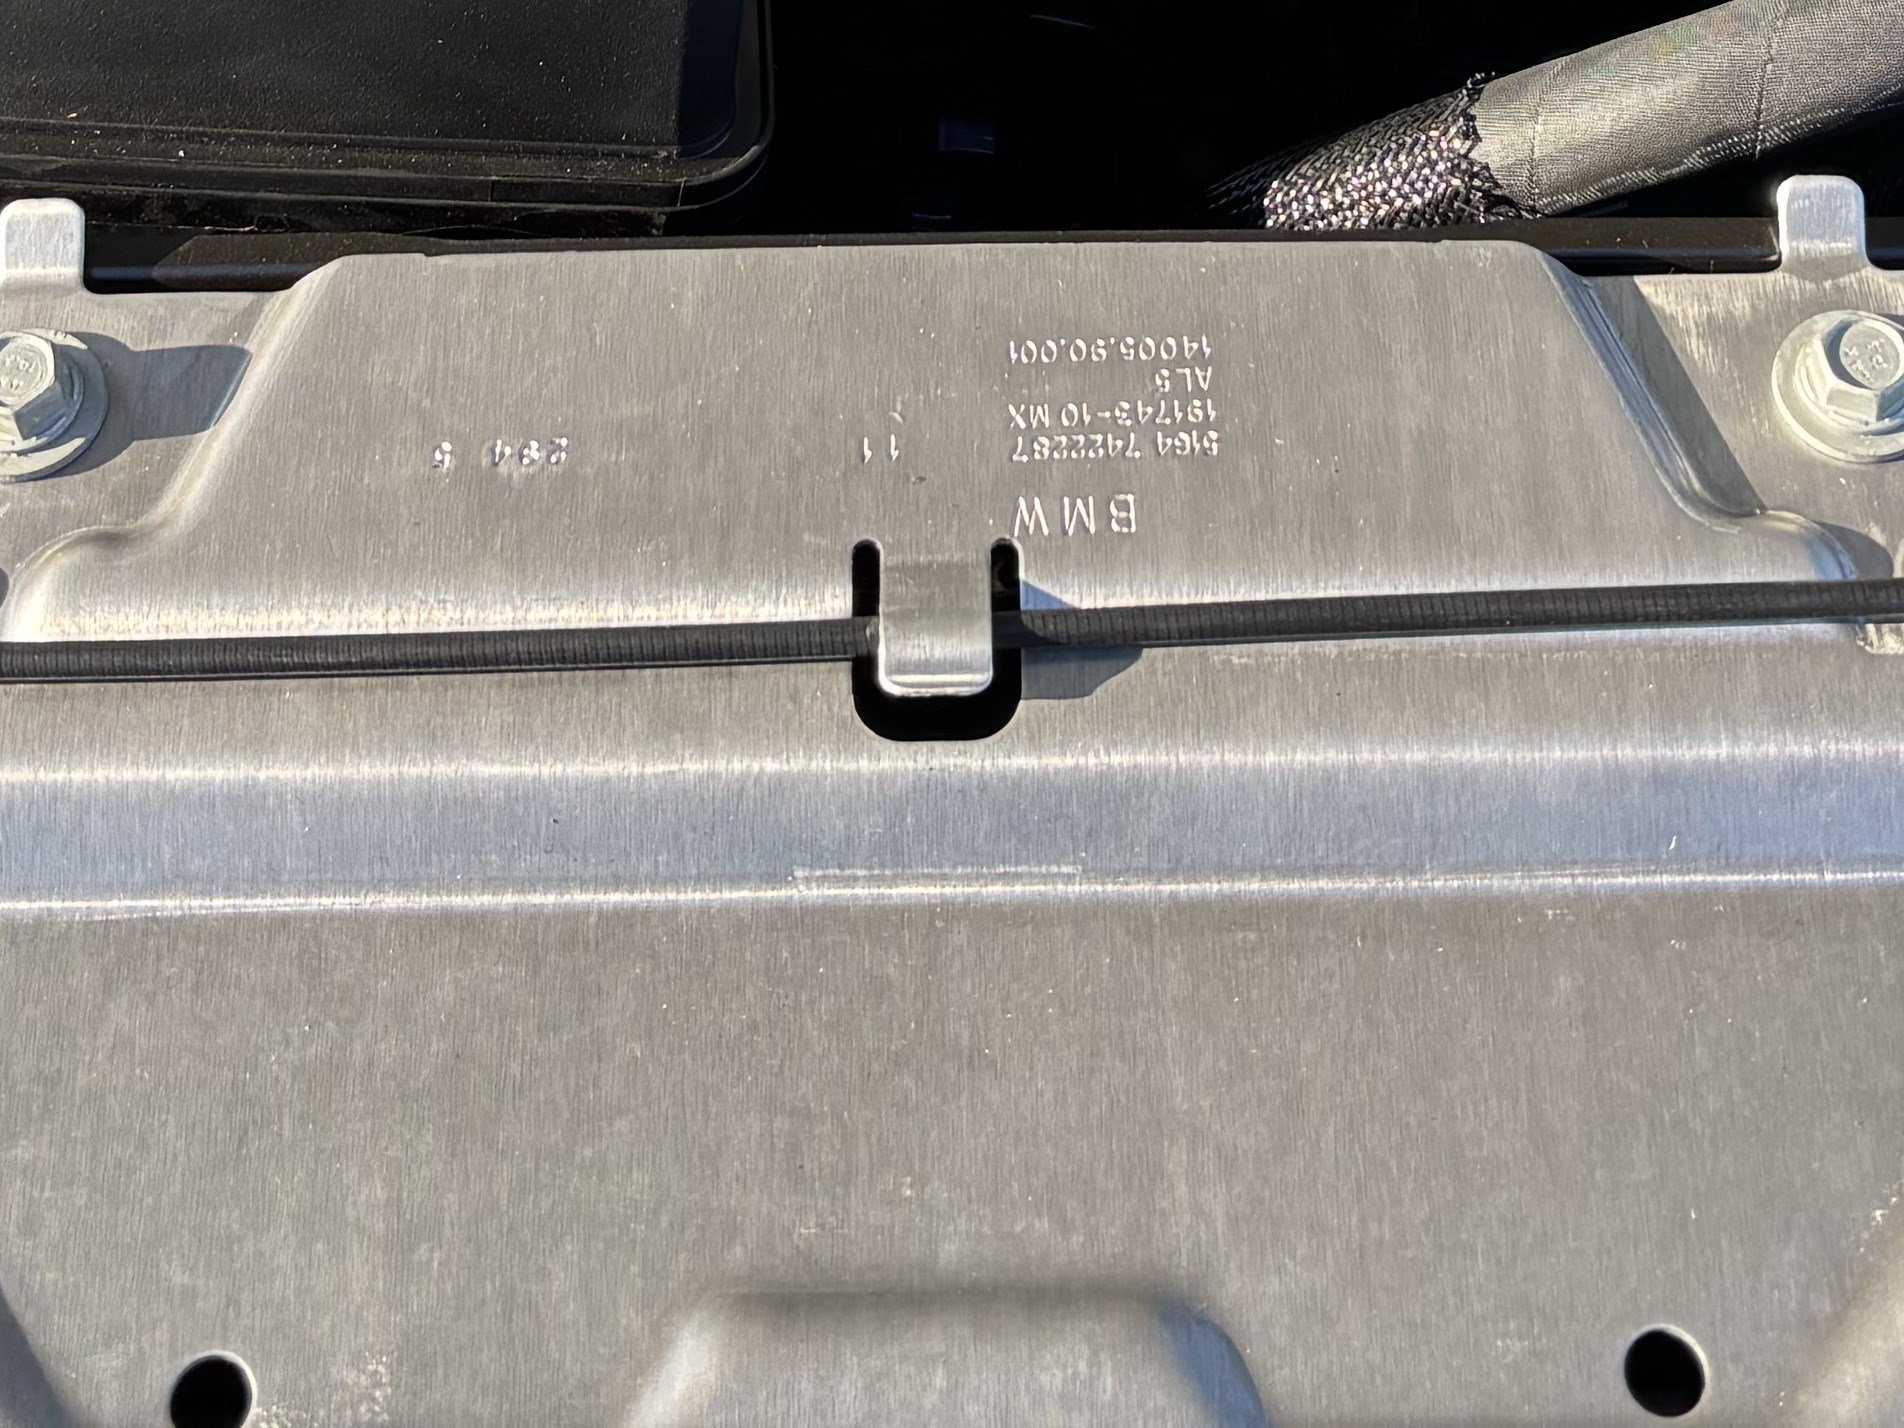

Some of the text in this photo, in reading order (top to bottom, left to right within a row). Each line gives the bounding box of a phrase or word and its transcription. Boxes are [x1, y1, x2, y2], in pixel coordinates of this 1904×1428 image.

[1009, 334, 1213, 365] 14005.90.001
[1007, 403, 1050, 430] MX
[1012, 430, 1219, 462] 5164 7422287
[1012, 494, 1137, 537] BMW
